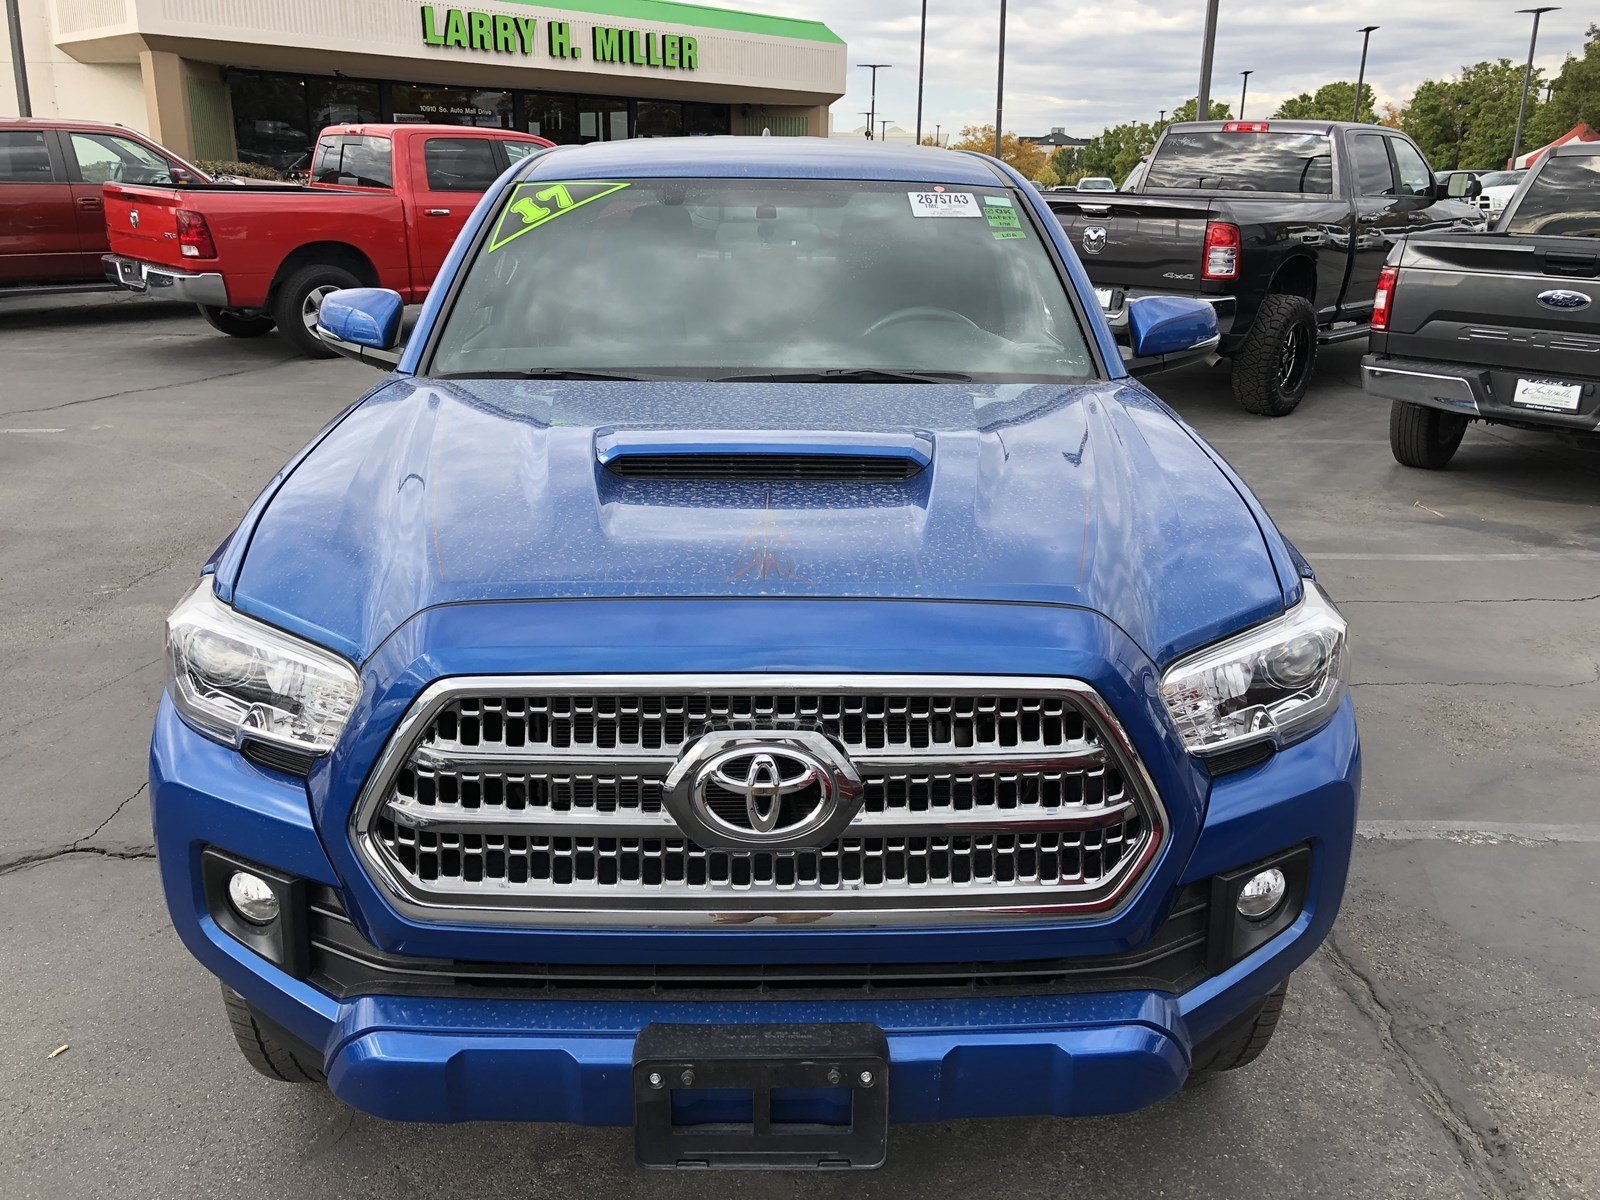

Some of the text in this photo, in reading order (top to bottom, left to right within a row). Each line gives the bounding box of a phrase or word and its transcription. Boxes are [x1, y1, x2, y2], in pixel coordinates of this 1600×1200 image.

[421, 6, 699, 70] LARRY H. MILLER
[420, 105, 437, 113] 10910
[478, 108, 493, 116] Drive
[510, 184, 574, 224] 17
[917, 193, 969, 205] 2675743
[1549, 293, 1579, 306] Ford
